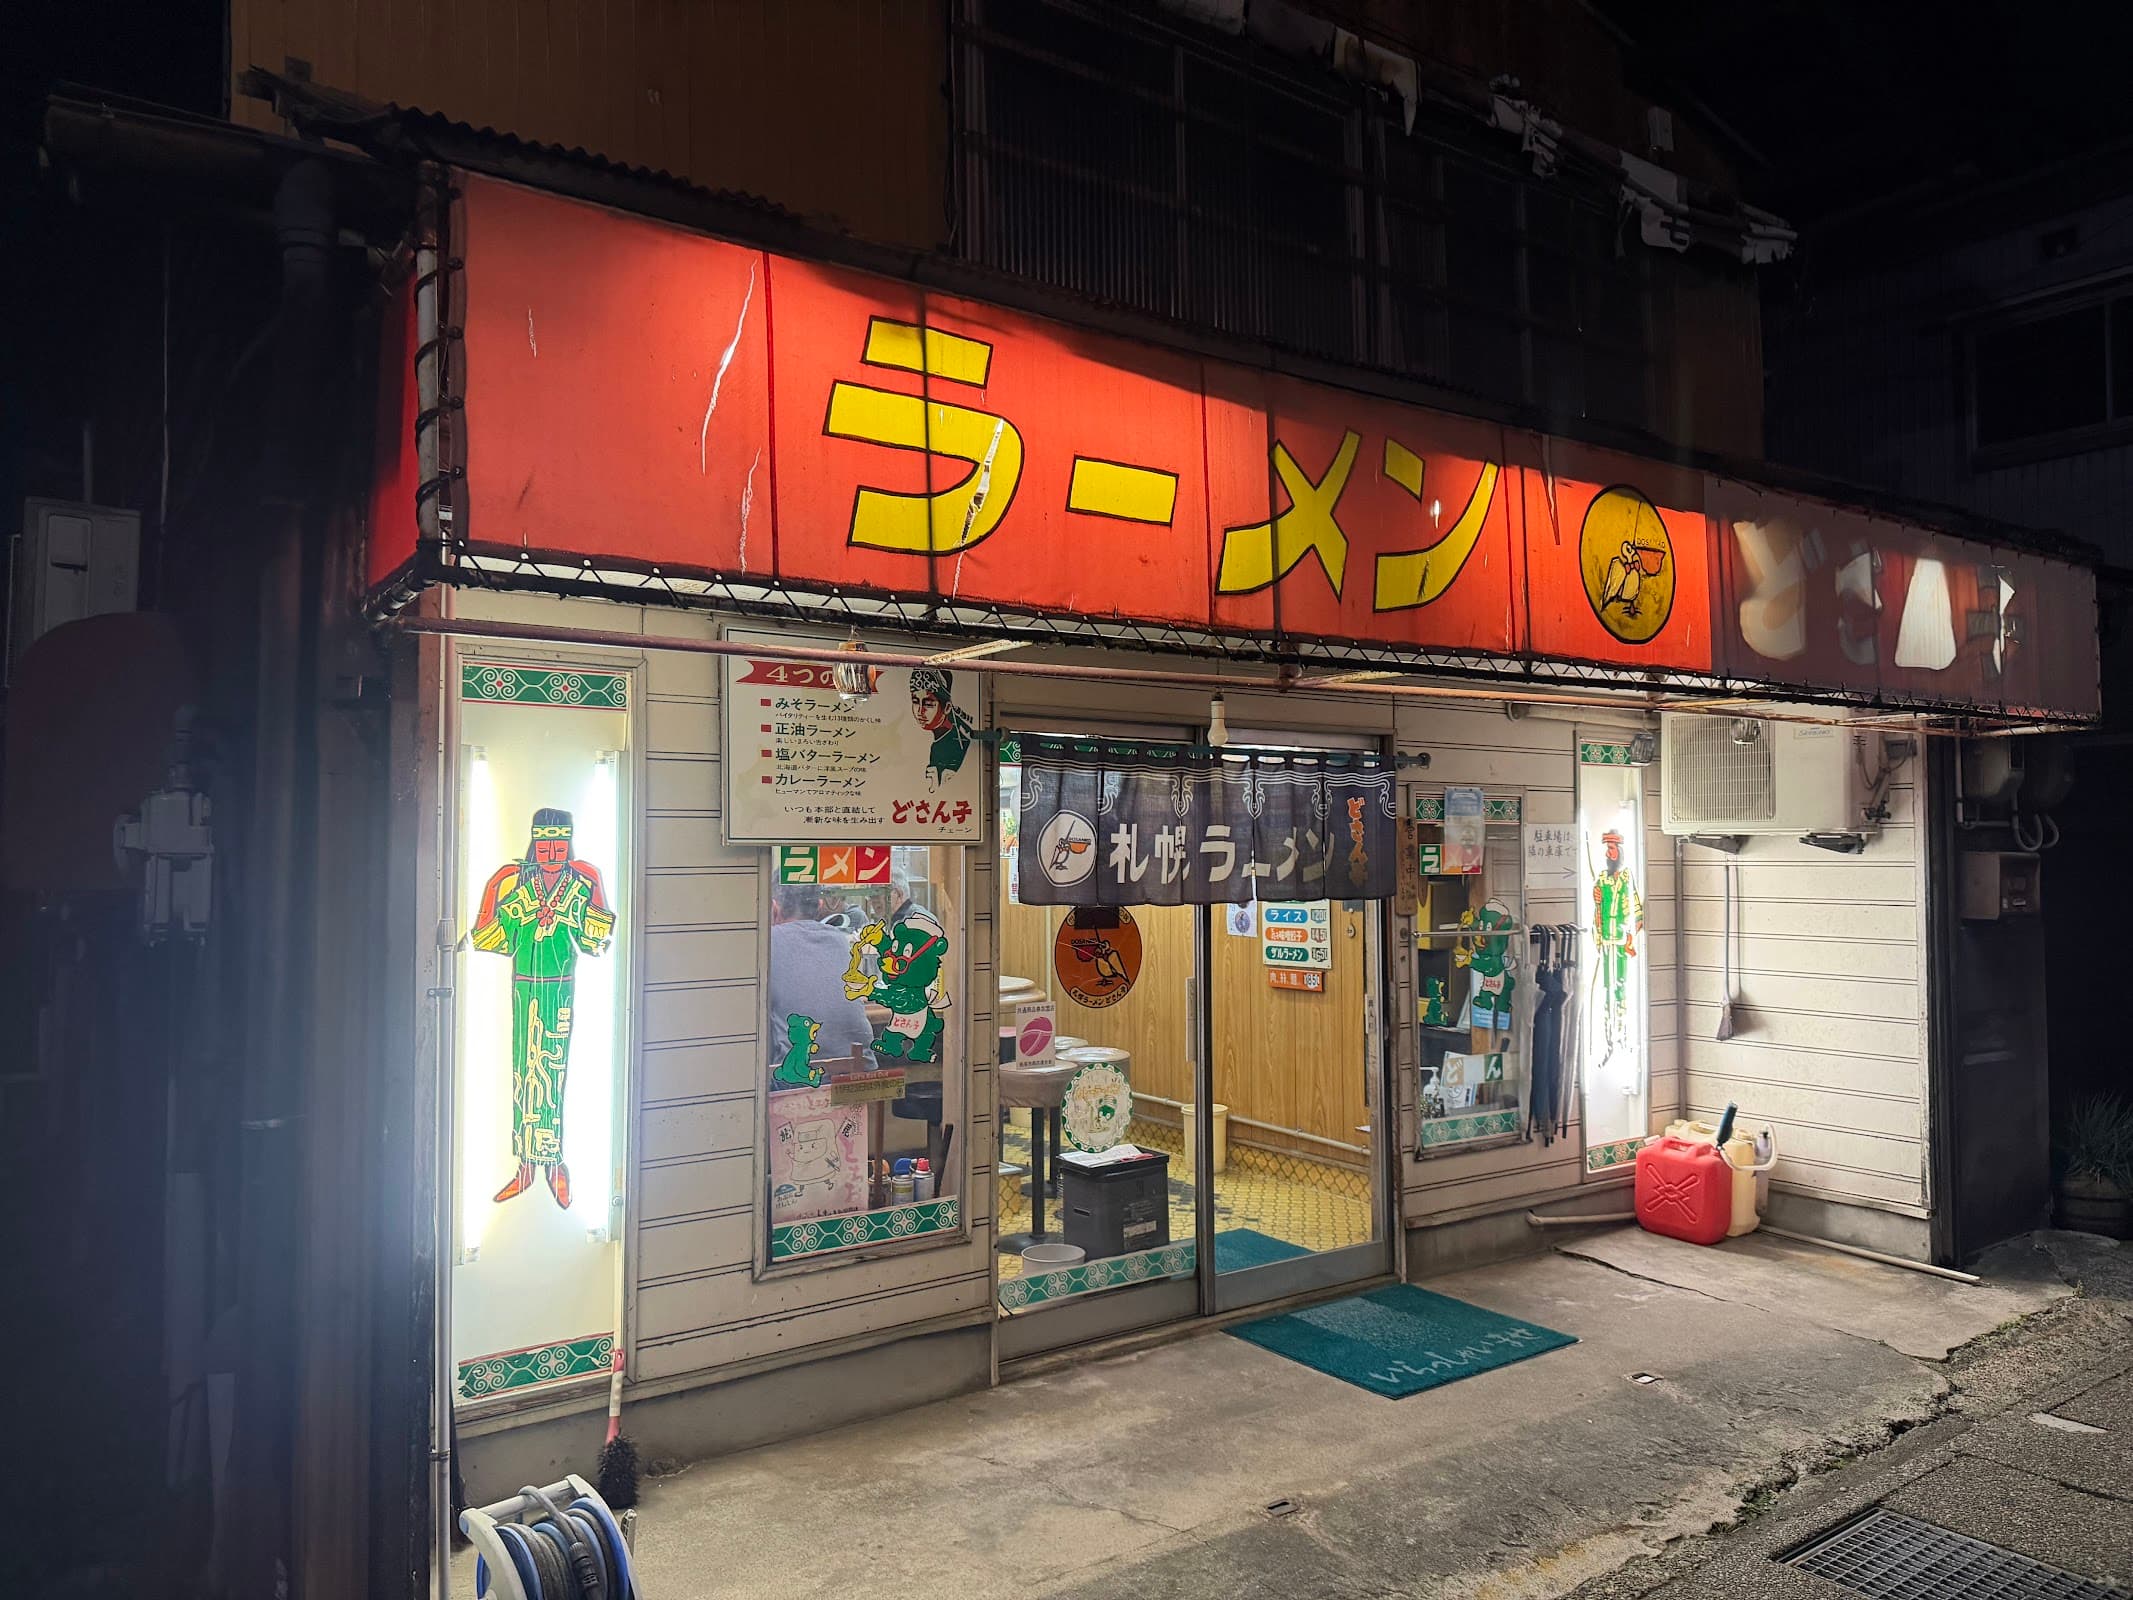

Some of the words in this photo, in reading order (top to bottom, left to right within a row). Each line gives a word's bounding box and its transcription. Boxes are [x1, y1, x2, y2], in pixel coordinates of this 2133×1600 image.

[823, 315, 1500, 612] ラーメン
[775, 697, 854, 713] みそラーメン
[775, 722, 856, 738] 正油ラーメン
[775, 747, 881, 764] 塩バターラーメン
[775, 773, 866, 788] カレーラーメン
[892, 799, 972, 824] どさん子
[938, 826, 972, 834] チェーン
[1270, 909, 1303, 921] ライス
[1368, 1327, 1542, 1383] いらっしゃいませ
